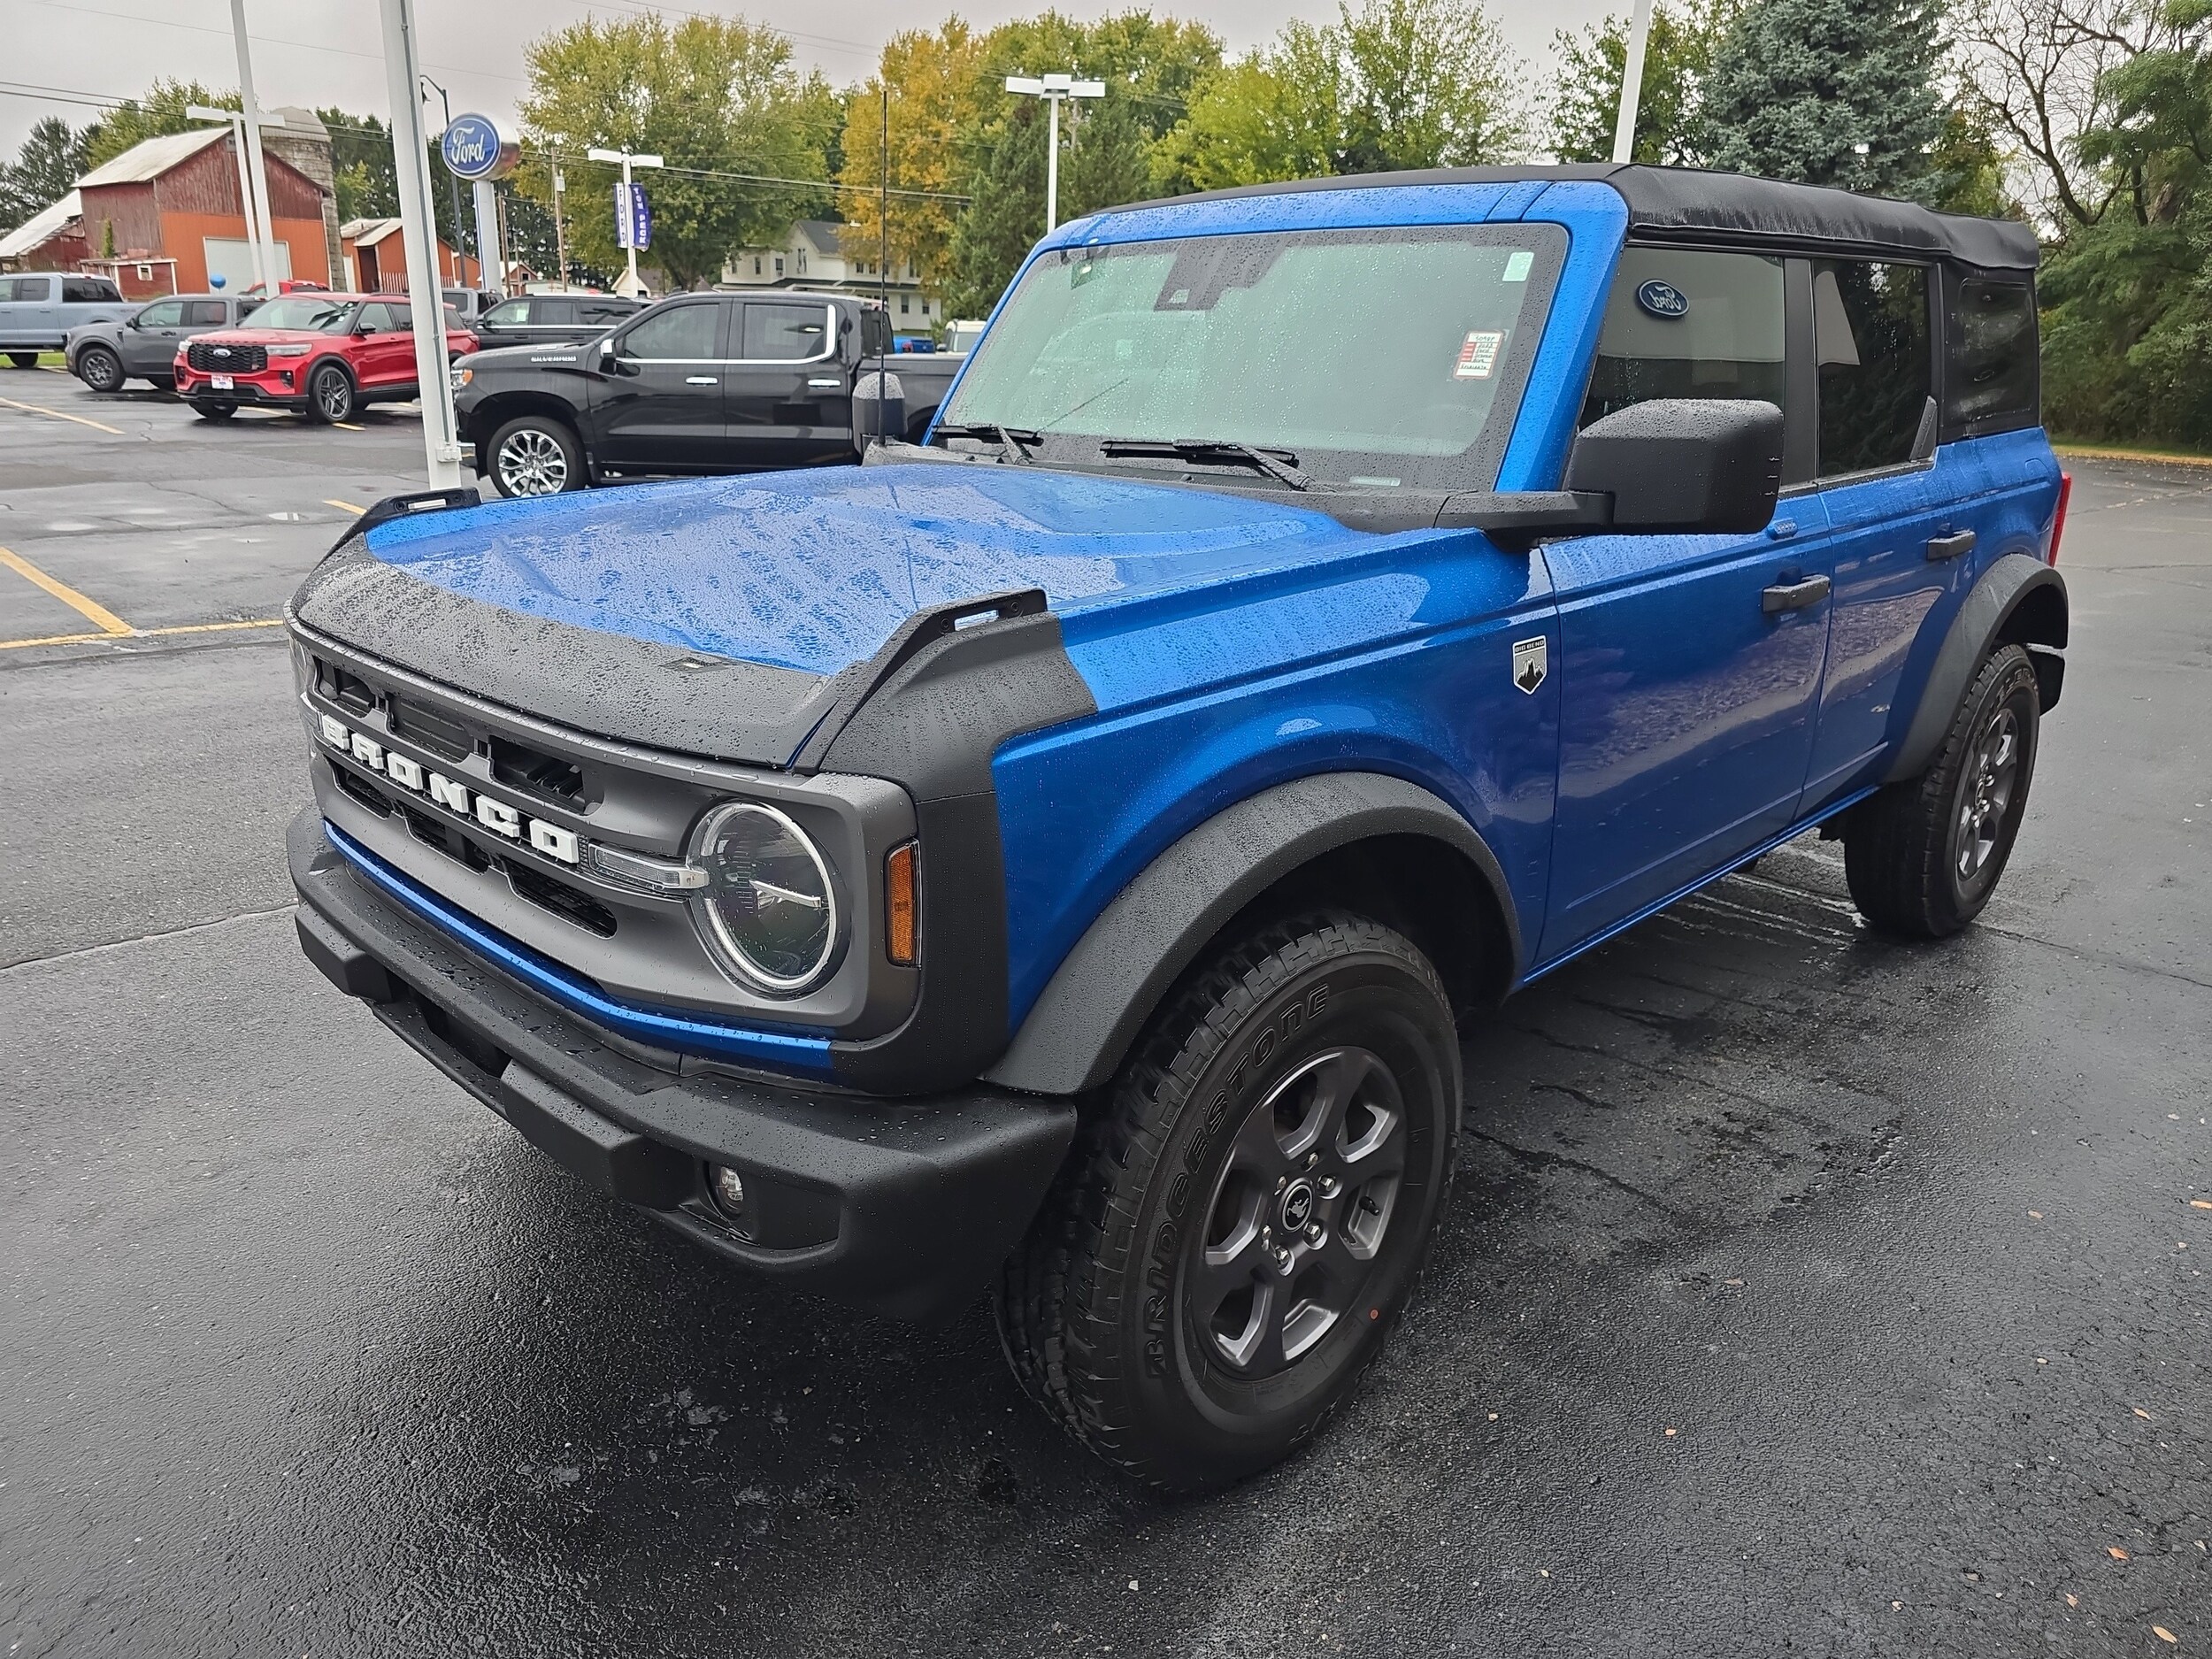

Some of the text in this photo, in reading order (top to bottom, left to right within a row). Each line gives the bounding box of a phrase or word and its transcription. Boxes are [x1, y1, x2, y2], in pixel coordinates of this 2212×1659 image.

[451, 126, 485, 165] Ford
[634, 188, 644, 210] TOM
[1526, 640, 1545, 649] BEND
[321, 714, 580, 864] BRONCO
[1144, 982, 1330, 1378] BRIDGESTONE
